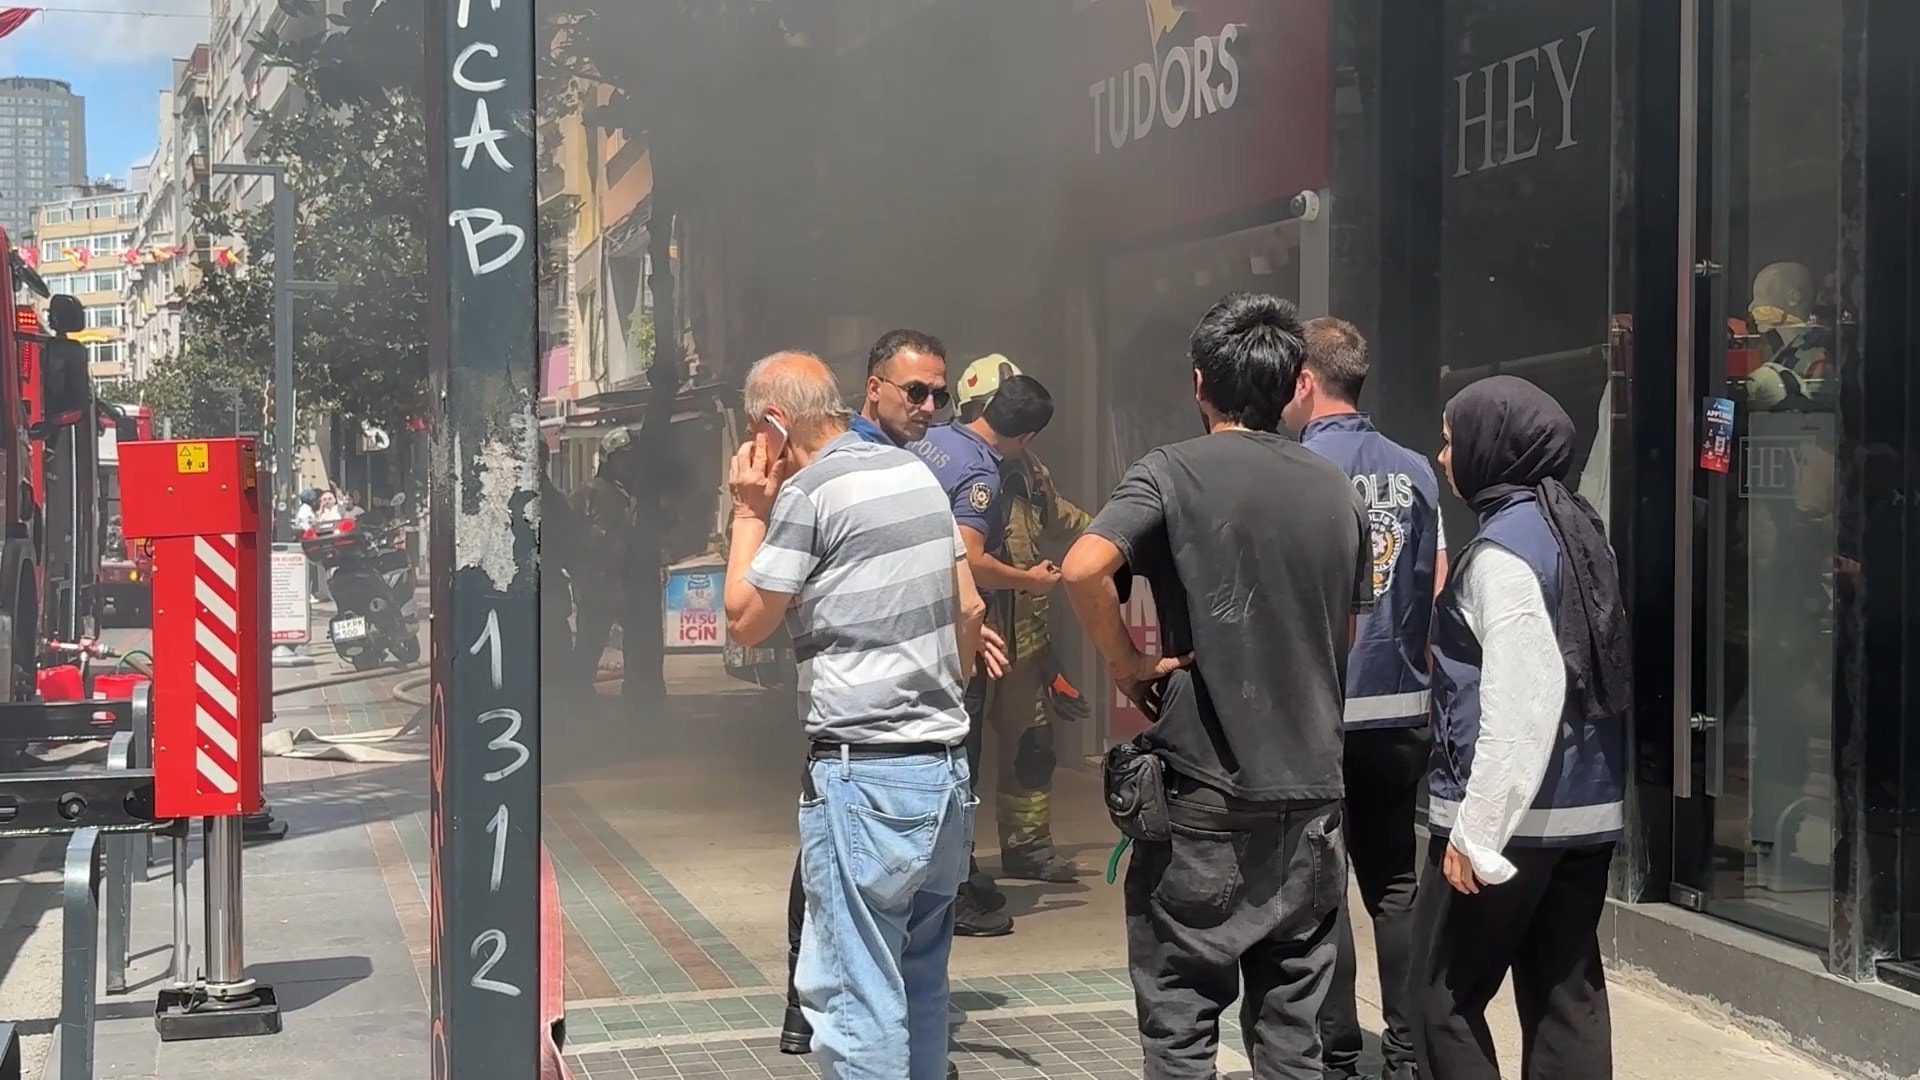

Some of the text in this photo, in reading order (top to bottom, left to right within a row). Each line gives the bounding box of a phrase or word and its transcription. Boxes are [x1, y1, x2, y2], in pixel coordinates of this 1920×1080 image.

[1089, 23, 1240, 155] TUDORS
[1452, 27, 1596, 178] HEY
[1744, 446, 1807, 488] HEY
[699, 613, 717, 625] SU
